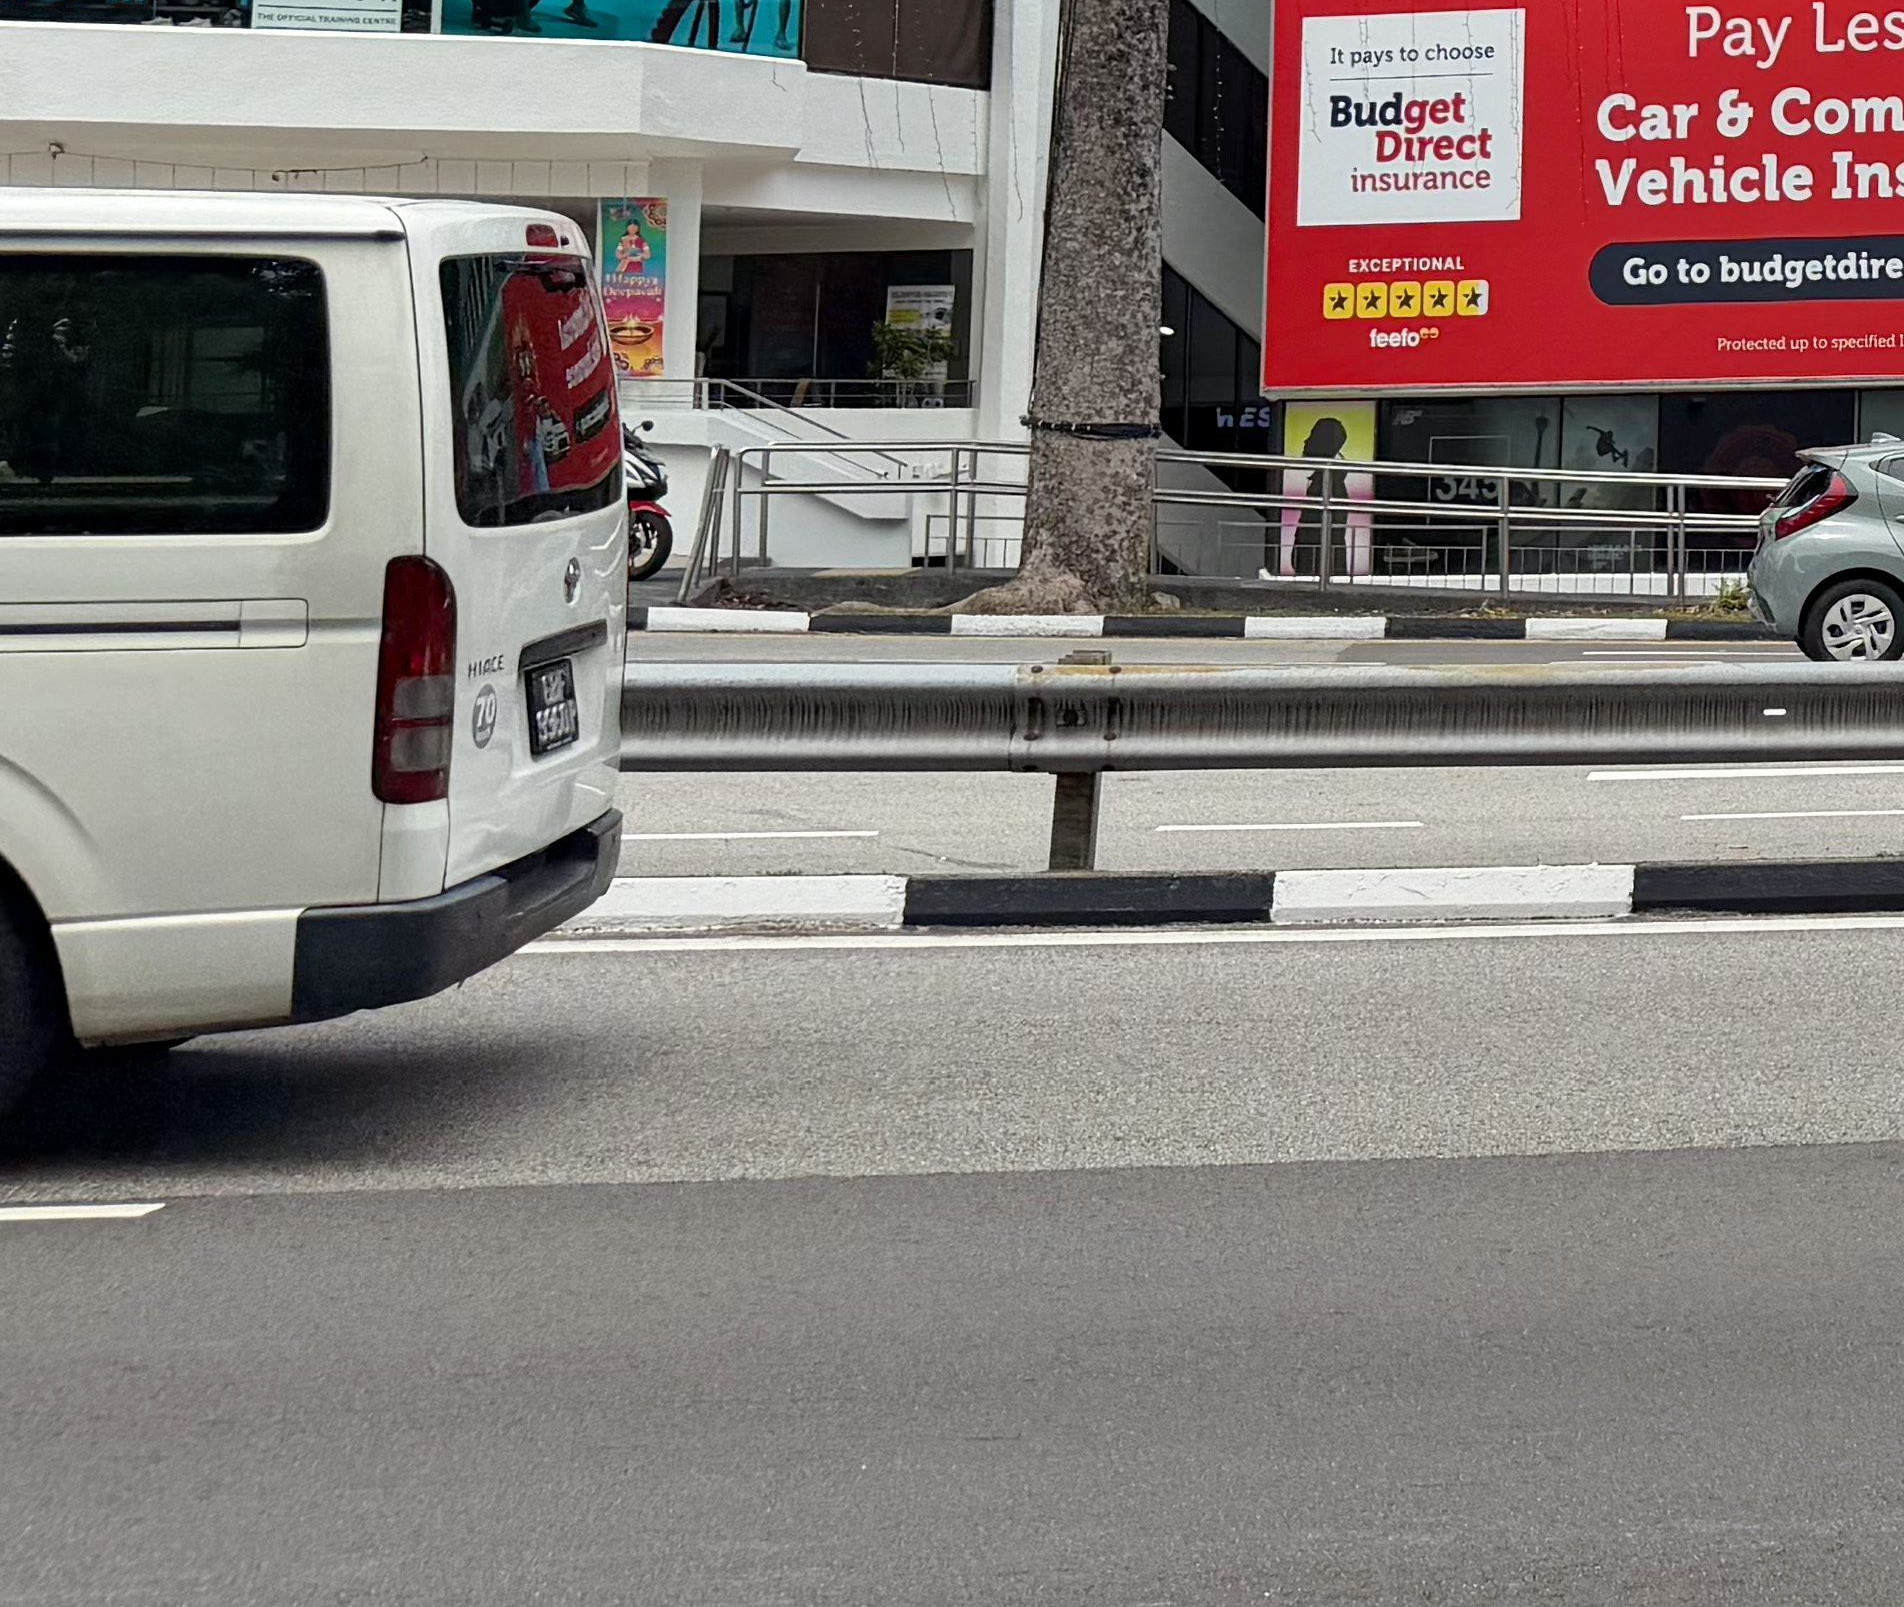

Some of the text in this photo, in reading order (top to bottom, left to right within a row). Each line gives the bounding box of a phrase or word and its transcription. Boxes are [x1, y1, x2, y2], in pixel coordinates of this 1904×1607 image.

[1685, 5, 1791, 68] Pay
[1330, 44, 1495, 68] It pays to choose
[1330, 92, 1466, 134] Budget
[1596, 92, 1699, 142] Car
[1715, 88, 1754, 137] &
[1375, 128, 1492, 163] Direct
[1351, 167, 1491, 192] insurance
[1594, 152, 1814, 206] Vehicle
[1349, 256, 1465, 273] EXCEPTIONAL
[1622, 256, 1668, 286] Go
[1676, 254, 1711, 284] to
[1369, 327, 1420, 348] feefo
[1717, 336, 1786, 351] Protected
[1790, 338, 1809, 353] up
[1813, 337, 1828, 350] to
[1831, 334, 1896, 351] specified
[468, 654, 504, 678] HIACE
[476, 693, 496, 728] 70
